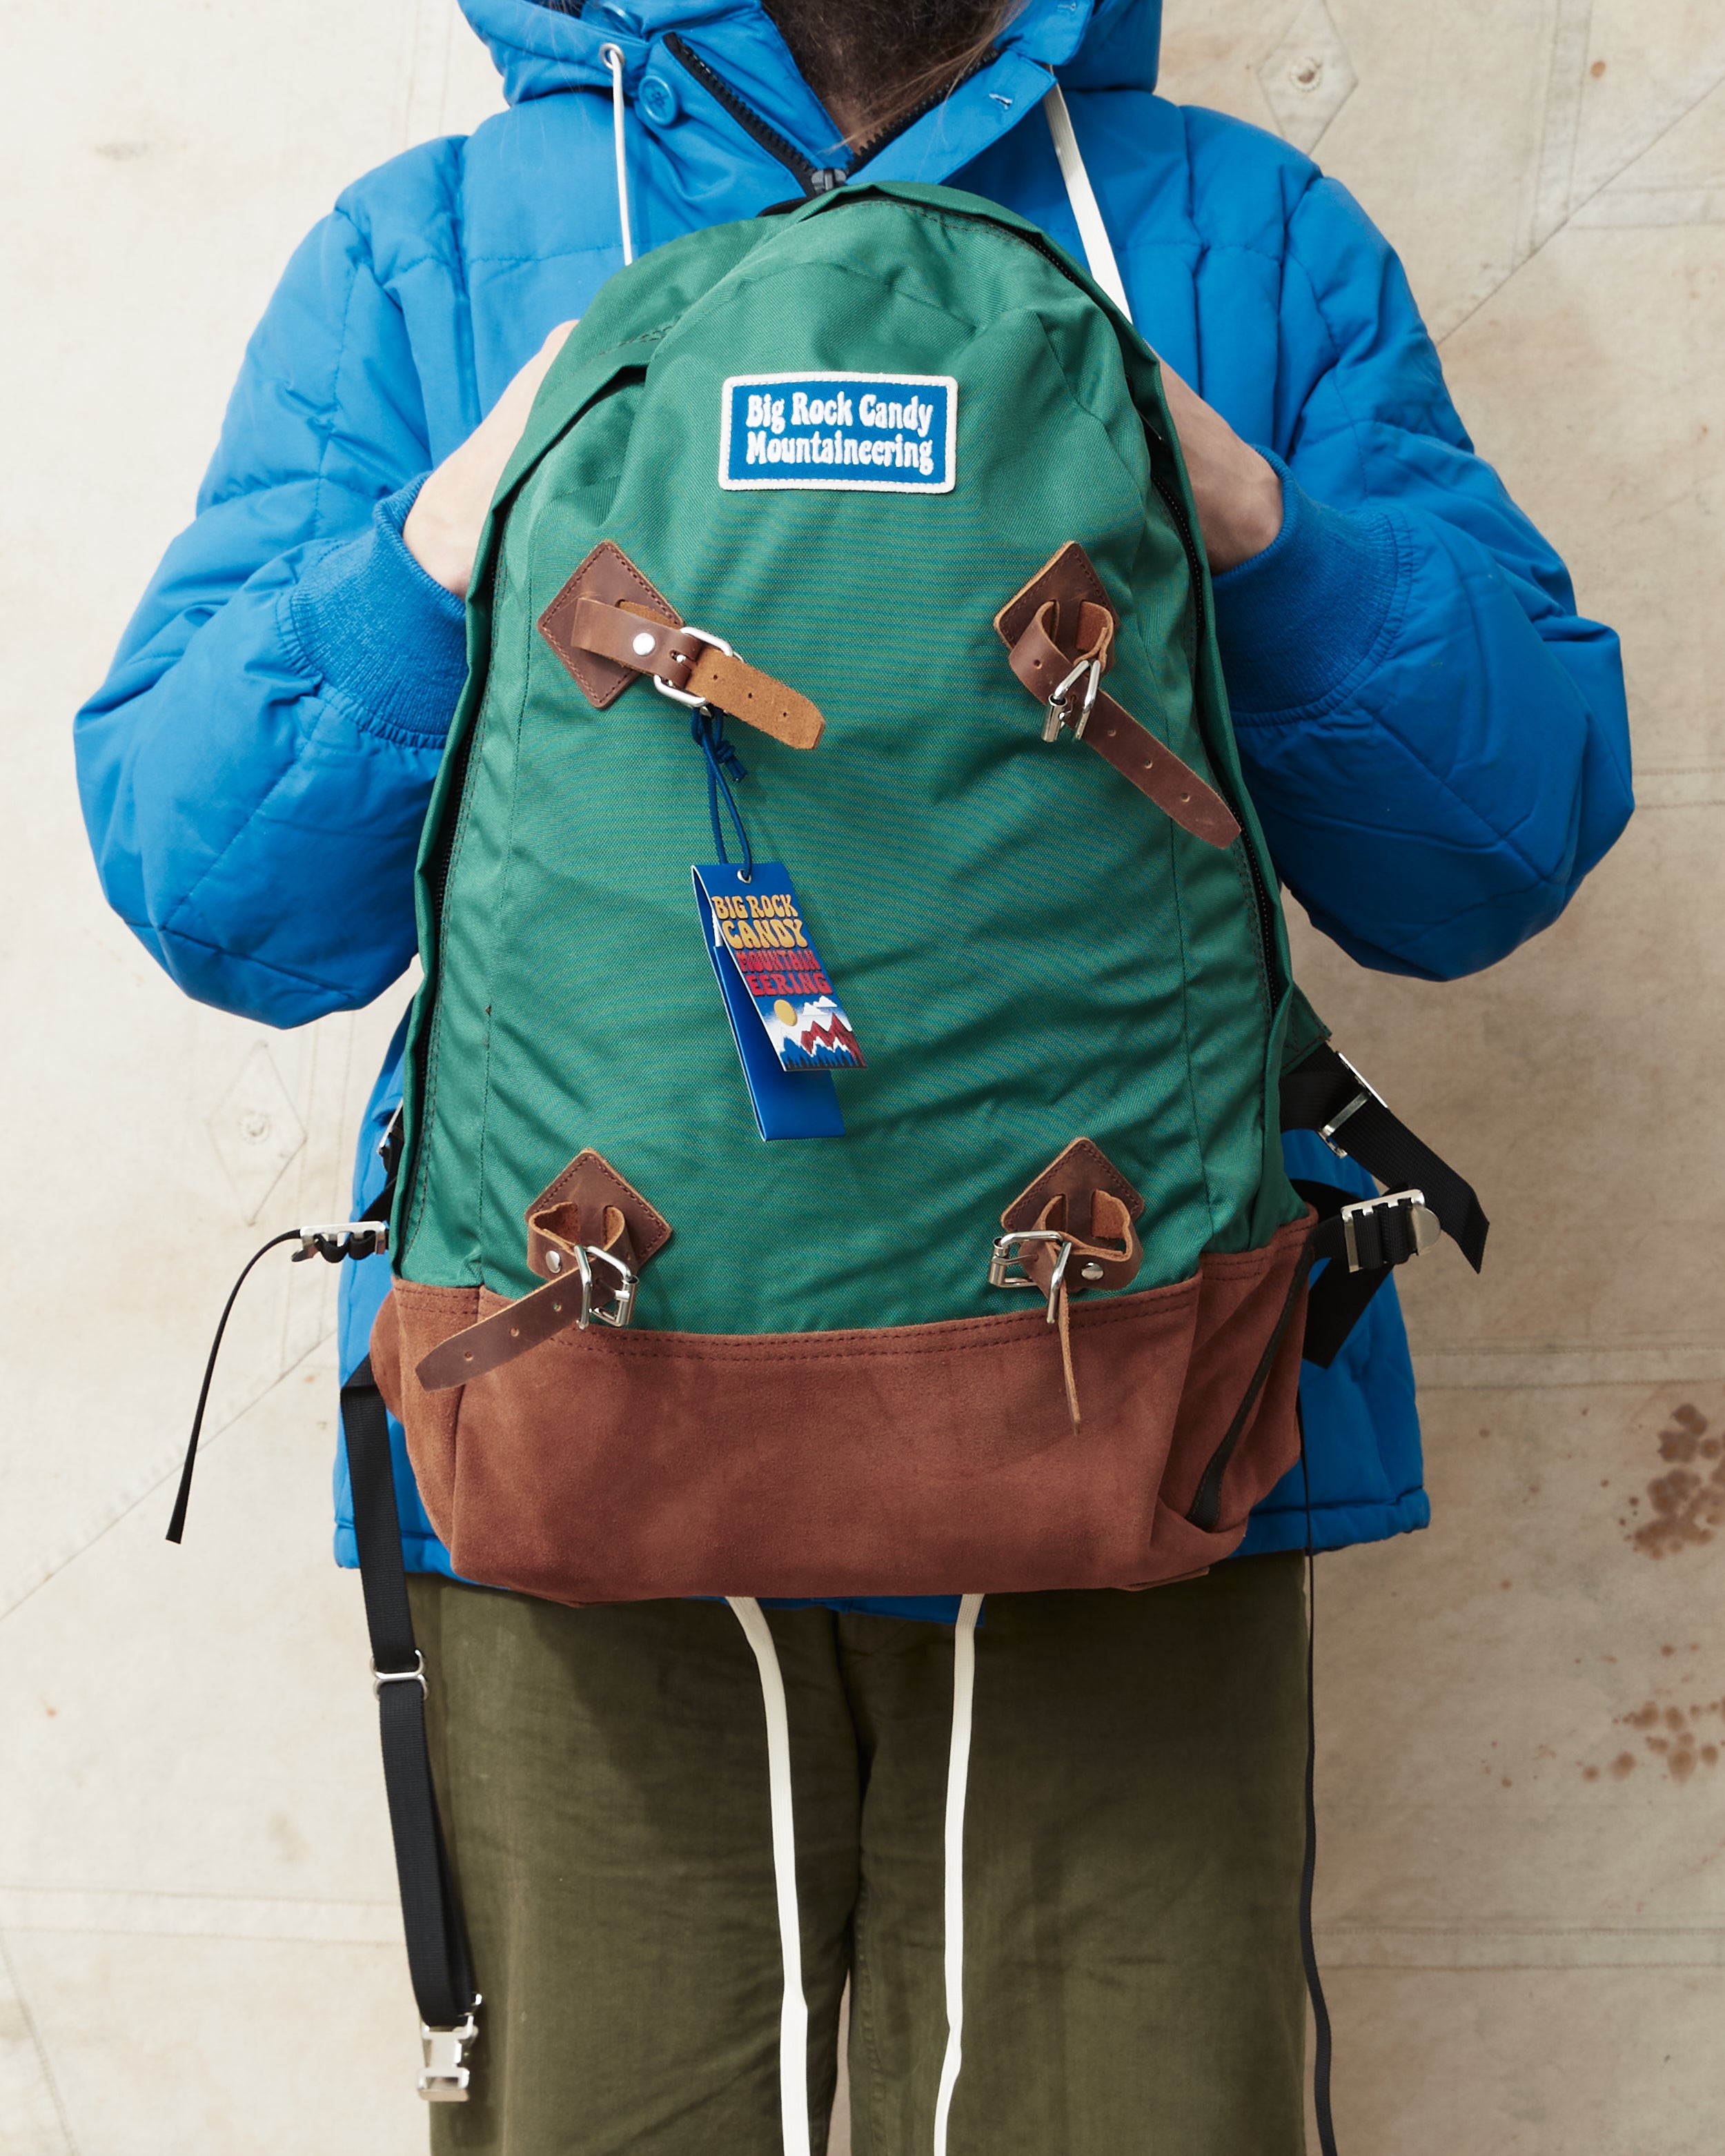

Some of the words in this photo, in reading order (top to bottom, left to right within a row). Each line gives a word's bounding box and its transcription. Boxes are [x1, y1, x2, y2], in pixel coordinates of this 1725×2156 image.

[746, 394, 785, 434] Big
[791, 391, 853, 426] Rock
[859, 394, 933, 437] Candy
[746, 430, 934, 475] Mountaineering
[711, 896, 749, 920] BIG
[745, 894, 798, 918] ROCK
[722, 919, 808, 949] CANDY
[735, 949, 820, 973] MOUNTAIN
[745, 972, 833, 996] EERING
